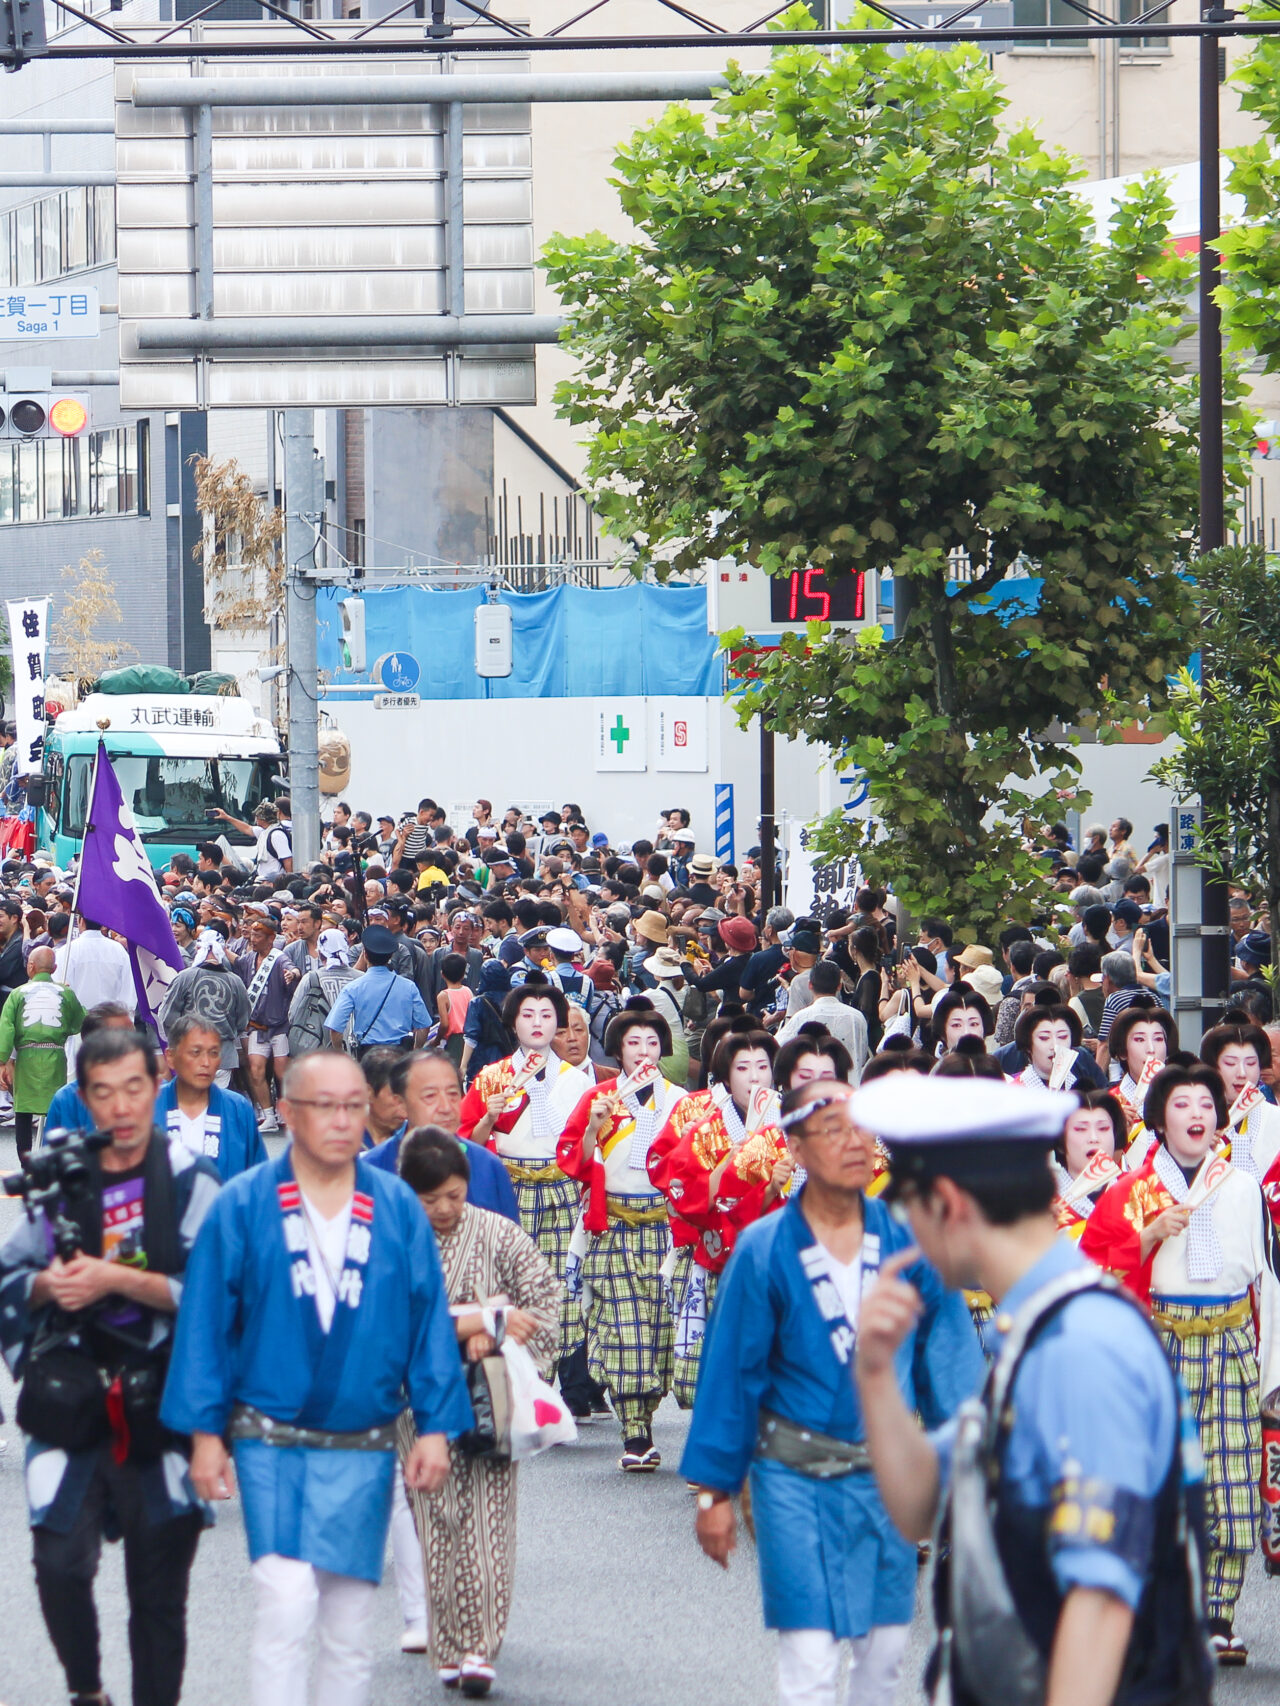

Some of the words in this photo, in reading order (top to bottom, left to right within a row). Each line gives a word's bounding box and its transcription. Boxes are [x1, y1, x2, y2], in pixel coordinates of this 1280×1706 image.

[17, 320, 48, 334] Saga
[53, 320, 59, 331] 1
[382, 697, 417, 706] 歩行者優先
[131, 706, 214, 727] 丸武運輸
